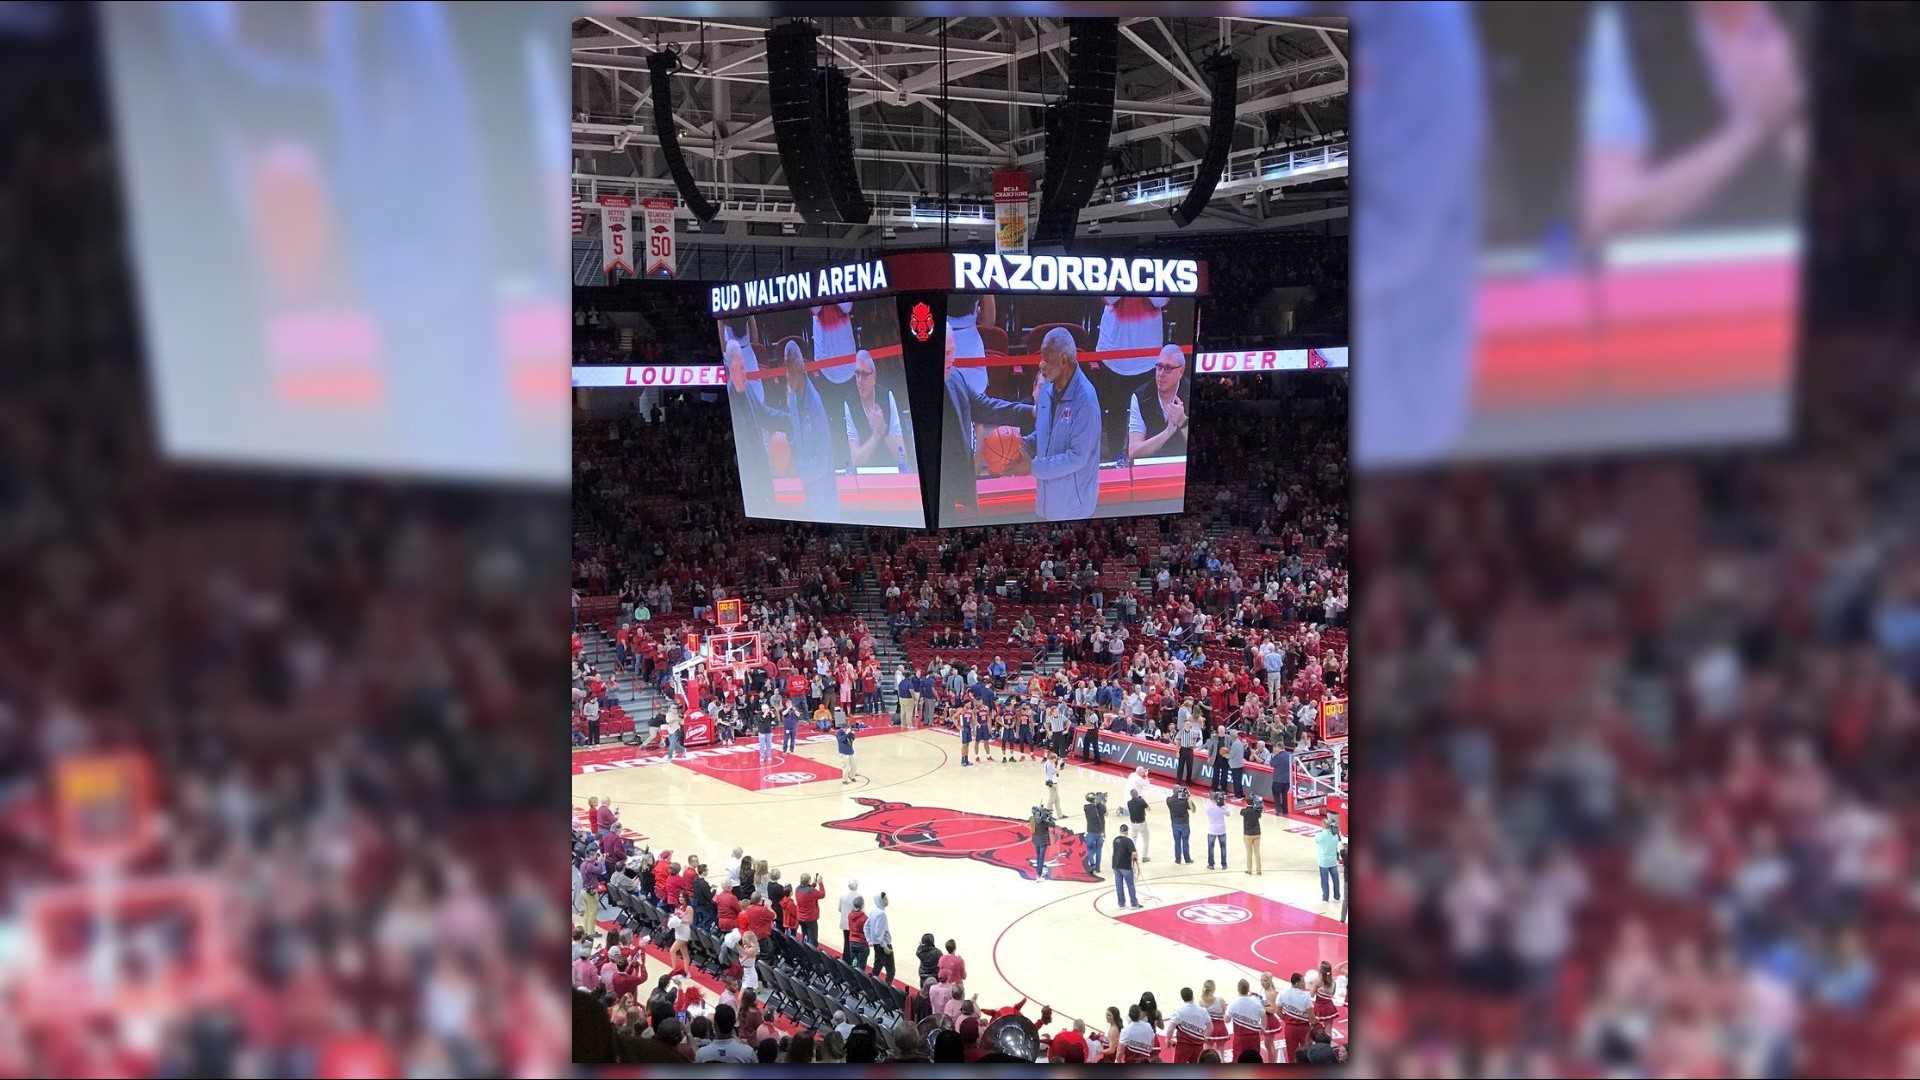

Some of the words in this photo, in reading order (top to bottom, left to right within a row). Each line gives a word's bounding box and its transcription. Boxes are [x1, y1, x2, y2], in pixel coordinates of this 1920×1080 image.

[613, 235, 624, 255] 5
[651, 236, 671, 256] 50
[712, 284, 740, 313] BUD
[744, 271, 811, 307] WALTON
[817, 260, 887, 297] ARENA
[953, 253, 1198, 292] RAZORBACKS
